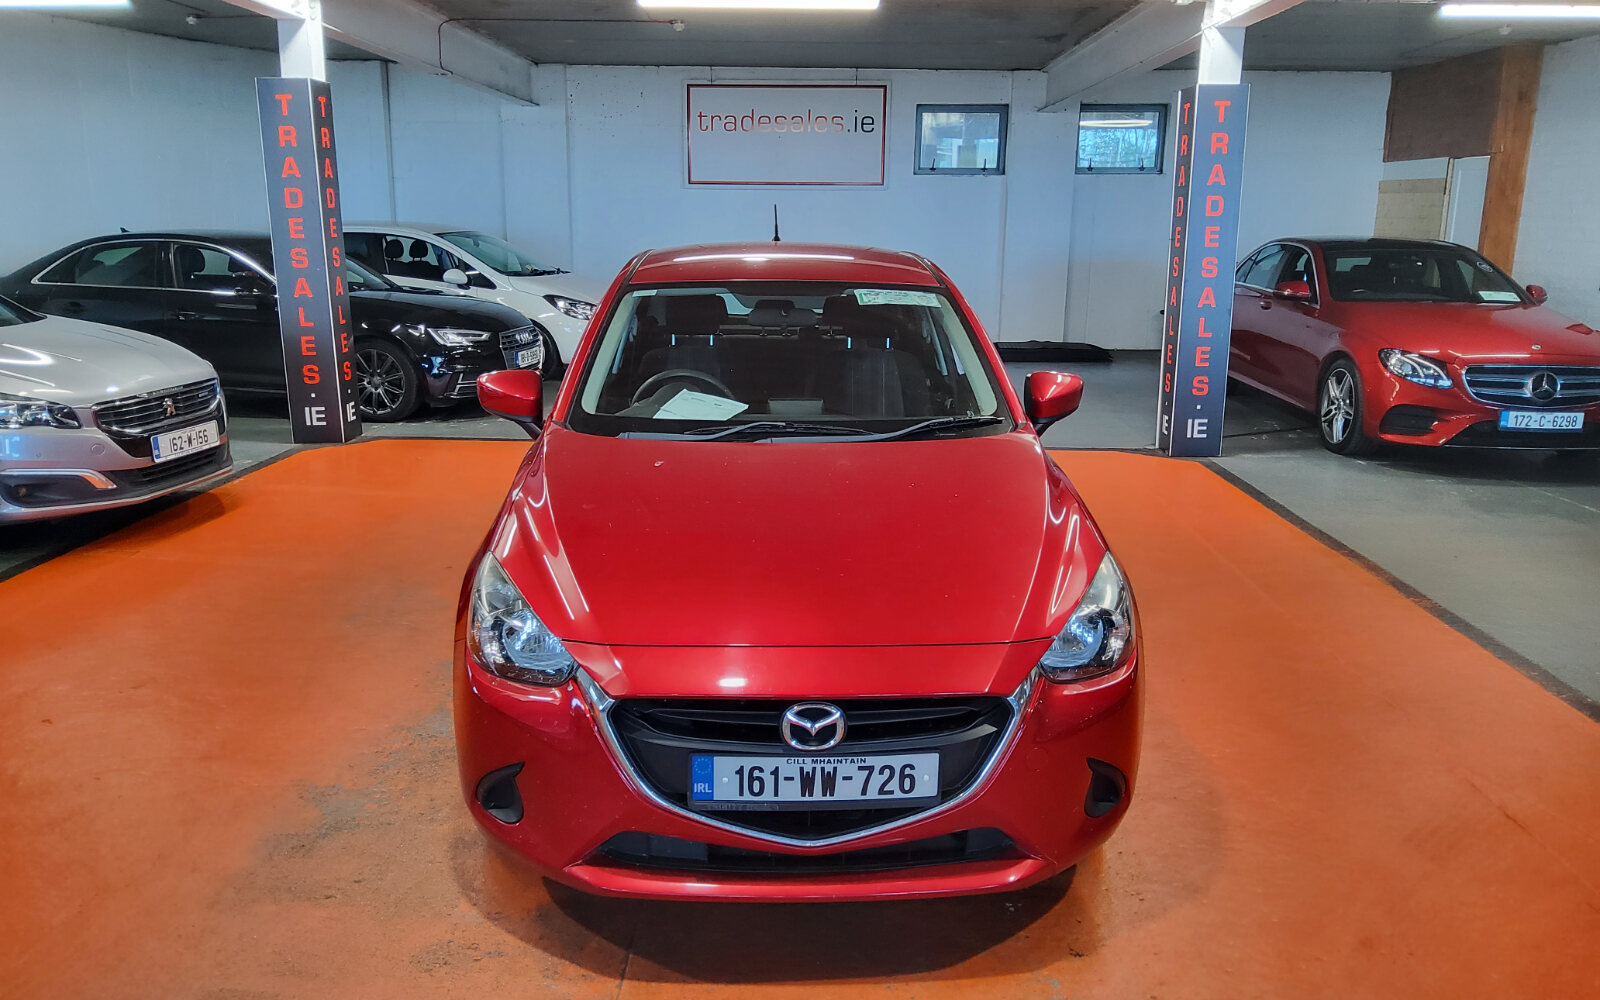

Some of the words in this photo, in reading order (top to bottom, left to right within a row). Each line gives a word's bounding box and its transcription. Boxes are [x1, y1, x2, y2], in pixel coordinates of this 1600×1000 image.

[697, 109, 875, 133] tradesales.ie
[275, 94, 327, 426] TRADESALES.IE
[318, 96, 357, 423] TRADESALES.IE
[1186, 100, 1231, 438] TRADESALES.IE
[1514, 414, 1578, 428] 172-C-6298
[169, 428, 209, 453] 162-W-156
[811, 757, 867, 765] MHAINTAIN
[693, 782, 712, 793] IRL
[734, 763, 916, 798] 161-WW-726
